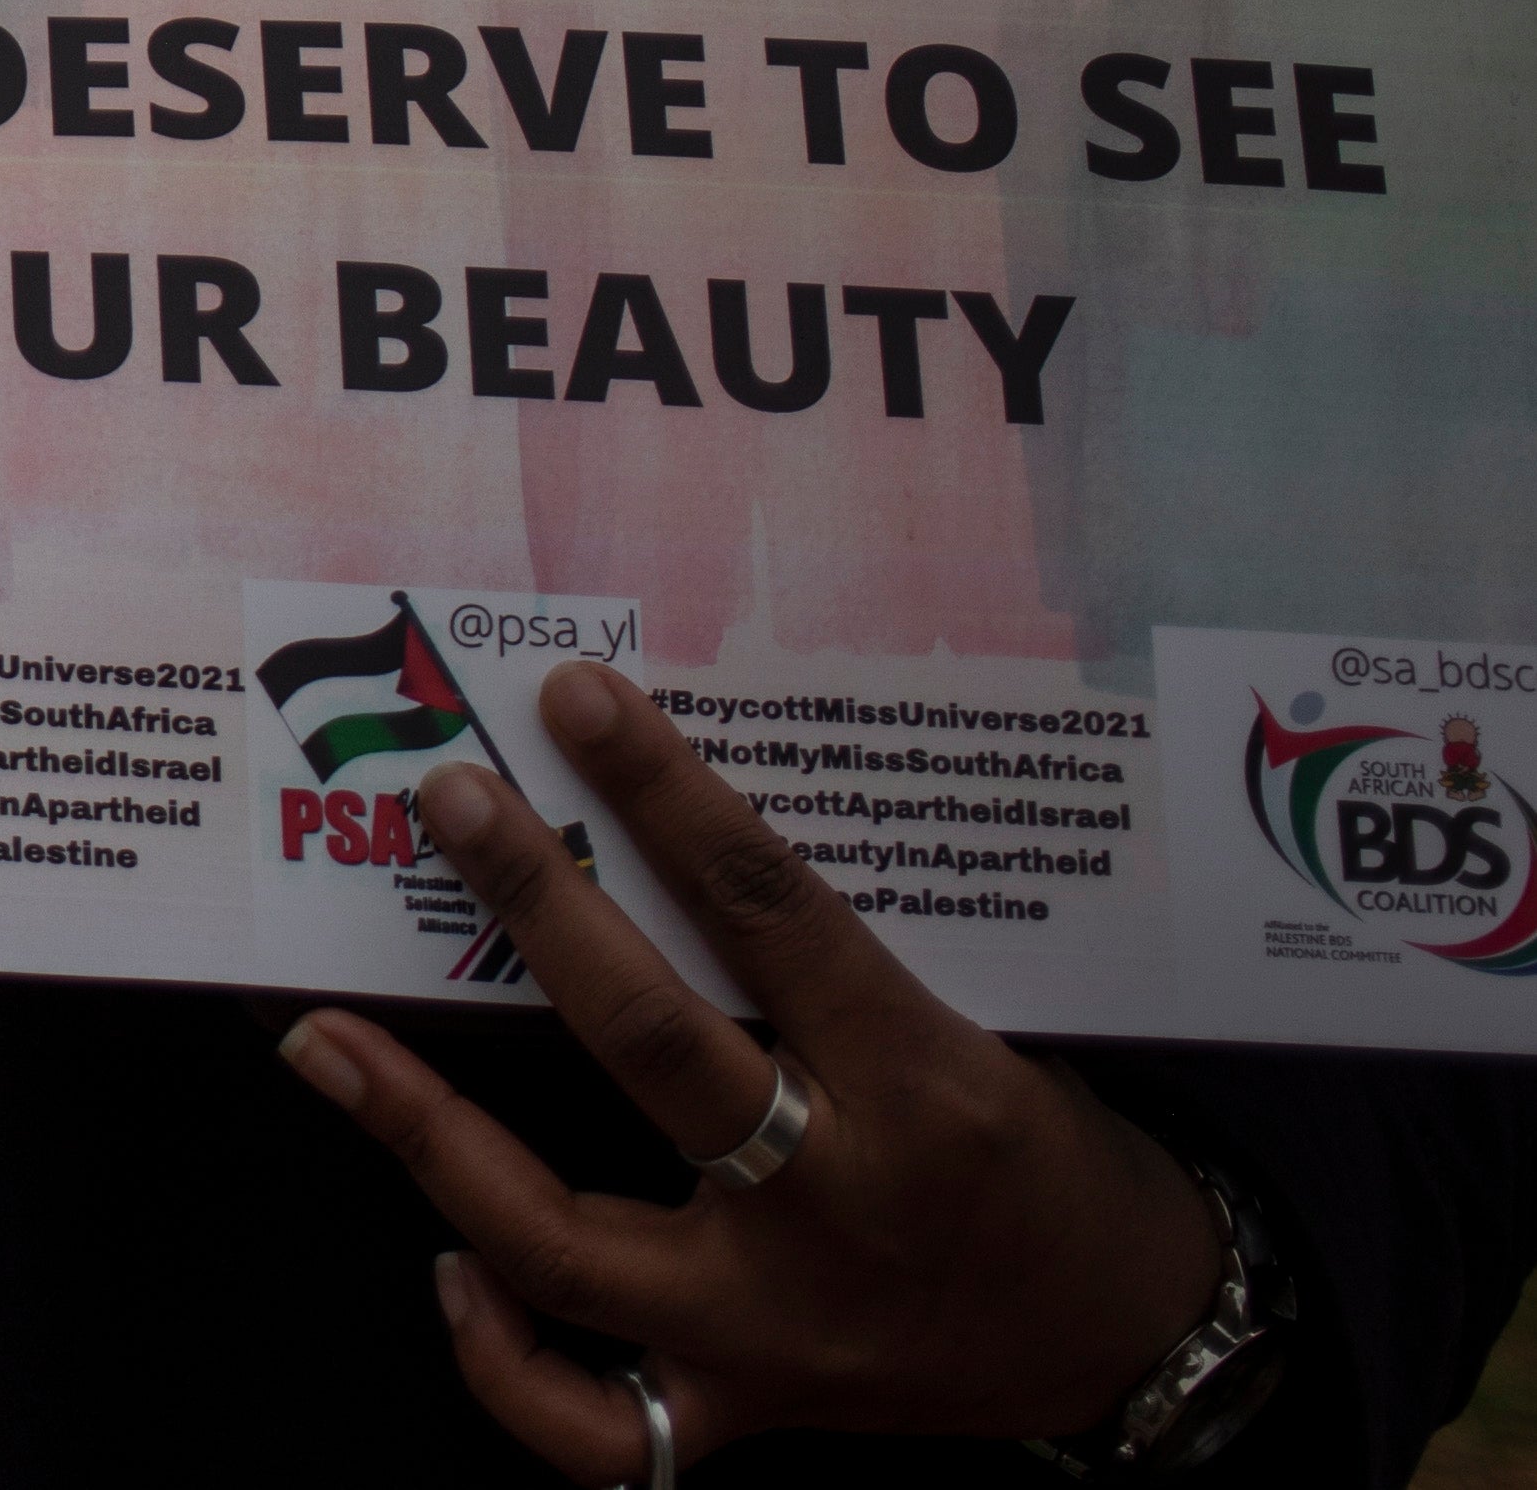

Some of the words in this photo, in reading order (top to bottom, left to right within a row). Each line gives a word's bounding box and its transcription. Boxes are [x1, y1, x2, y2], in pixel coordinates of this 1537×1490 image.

[765, 38, 1018, 173] TO
[1081, 53, 1386, 194] SEE
[337, 262, 1077, 426] BEAUTY
[450, 604, 636, 663] @psa_yl
[652, 689, 1150, 738] #BoycottMissUniverse2021
[1360, 760, 1425, 779] SOUTH
[1348, 778, 1434, 797] AFRICAN
[748, 793, 1131, 830] ycottApartheidIsrael
[280, 787, 416, 867] PSA
[794, 841, 1111, 875] eautyInApartheid
[1338, 801, 1510, 890] BDS
[395, 874, 463, 893] Palestine
[406, 896, 476, 916] Solidarity
[849, 890, 1049, 920] ePalestine
[1357, 890, 1497, 916] COALITION
[418, 917, 477, 936] Alliance
[1264, 932, 1326, 945] PALESTINE
[1328, 935, 1352, 947] BDS
[1266, 946, 1328, 960] NATIONAL
[1330, 950, 1402, 963] COMMITTEE
